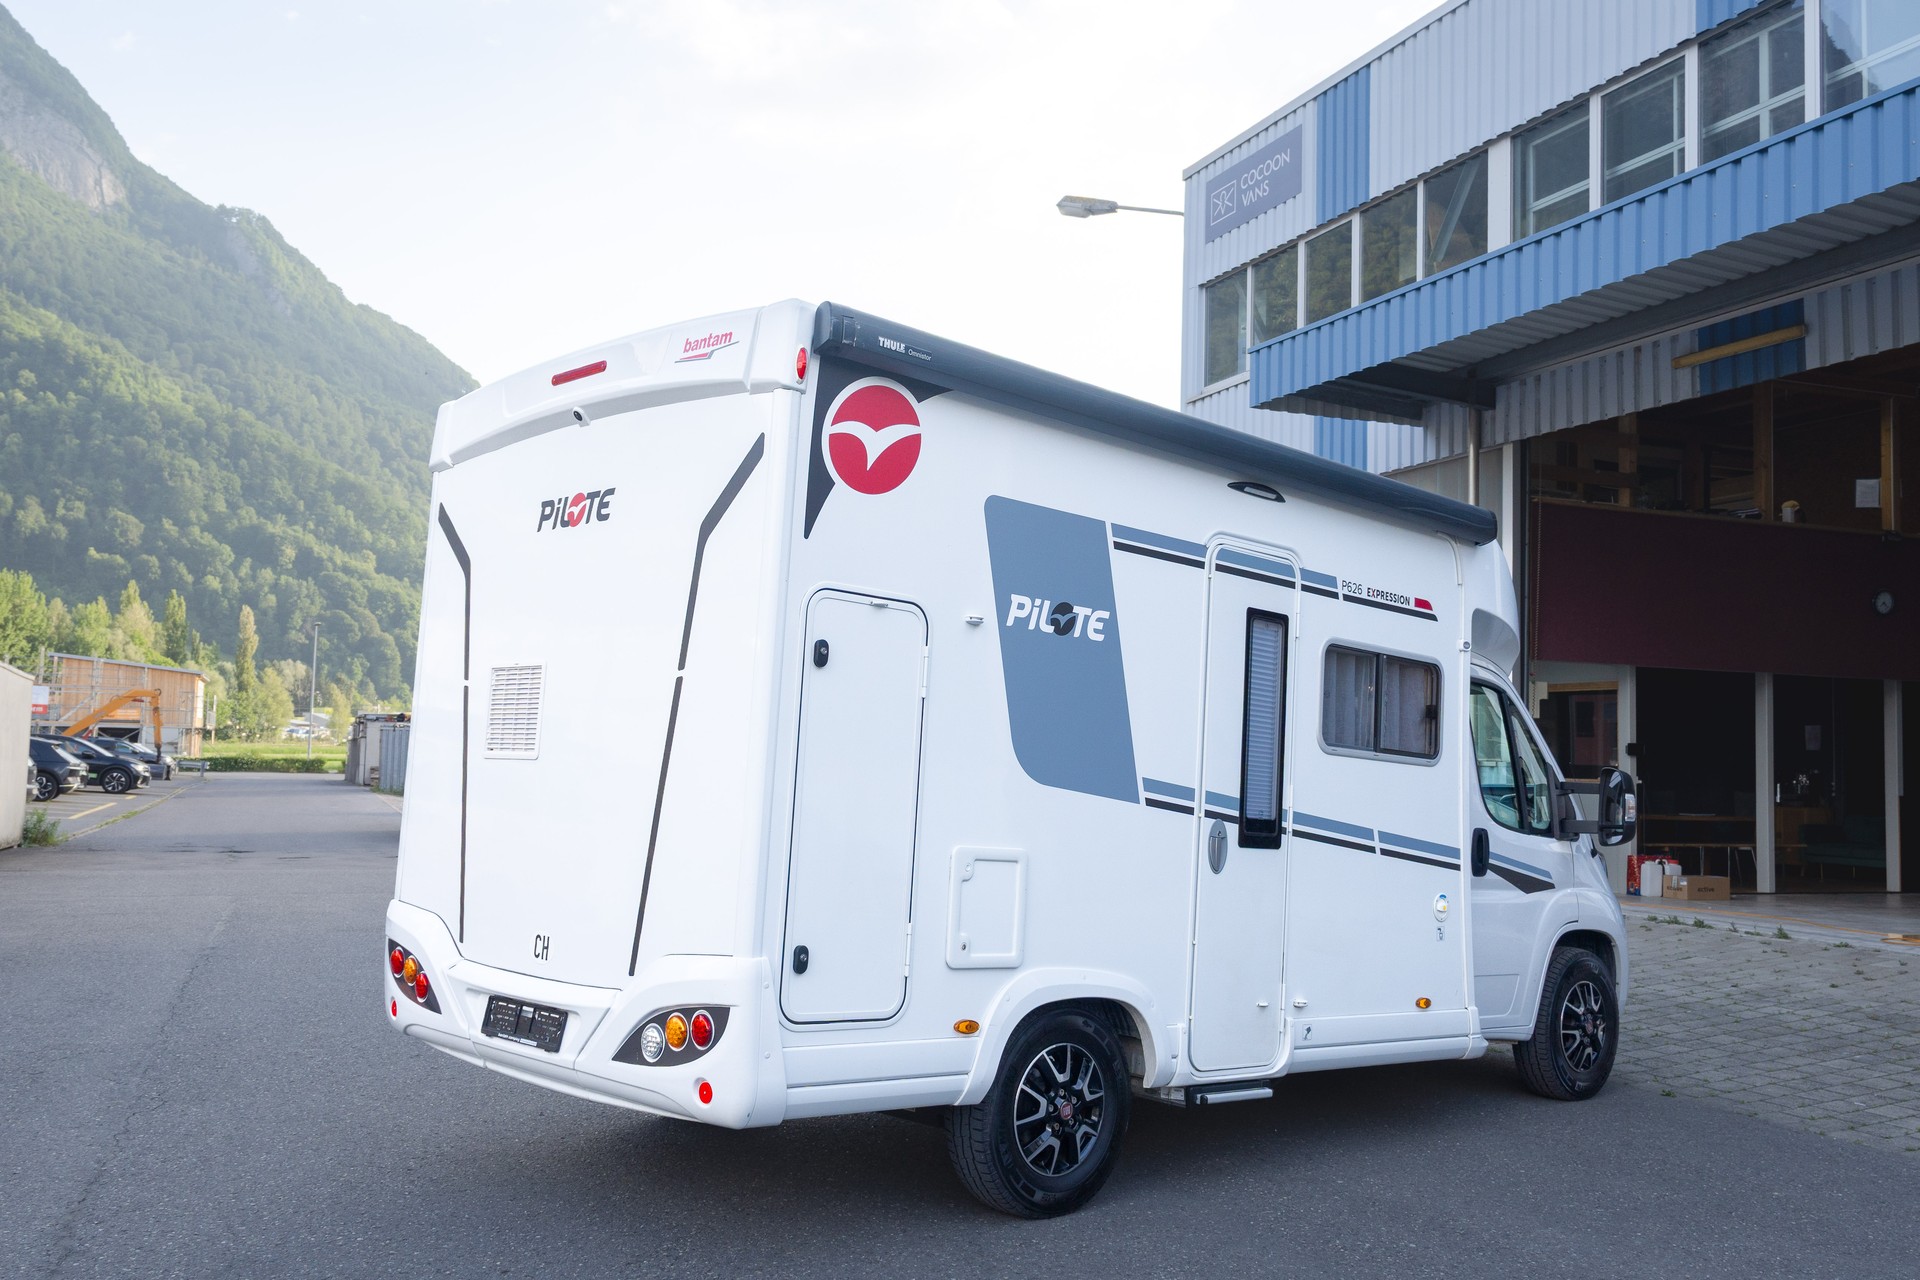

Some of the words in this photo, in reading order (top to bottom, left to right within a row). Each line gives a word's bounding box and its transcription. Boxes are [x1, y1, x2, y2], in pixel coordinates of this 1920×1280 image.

[1240, 148, 1290, 189] COCOON
[1241, 180, 1269, 207] VANS
[683, 331, 733, 353] bantam
[878, 336, 906, 353] THULE
[1341, 580, 1363, 595] P626
[1366, 587, 1411, 606] EXPRESSION
[533, 934, 550, 961] CH
